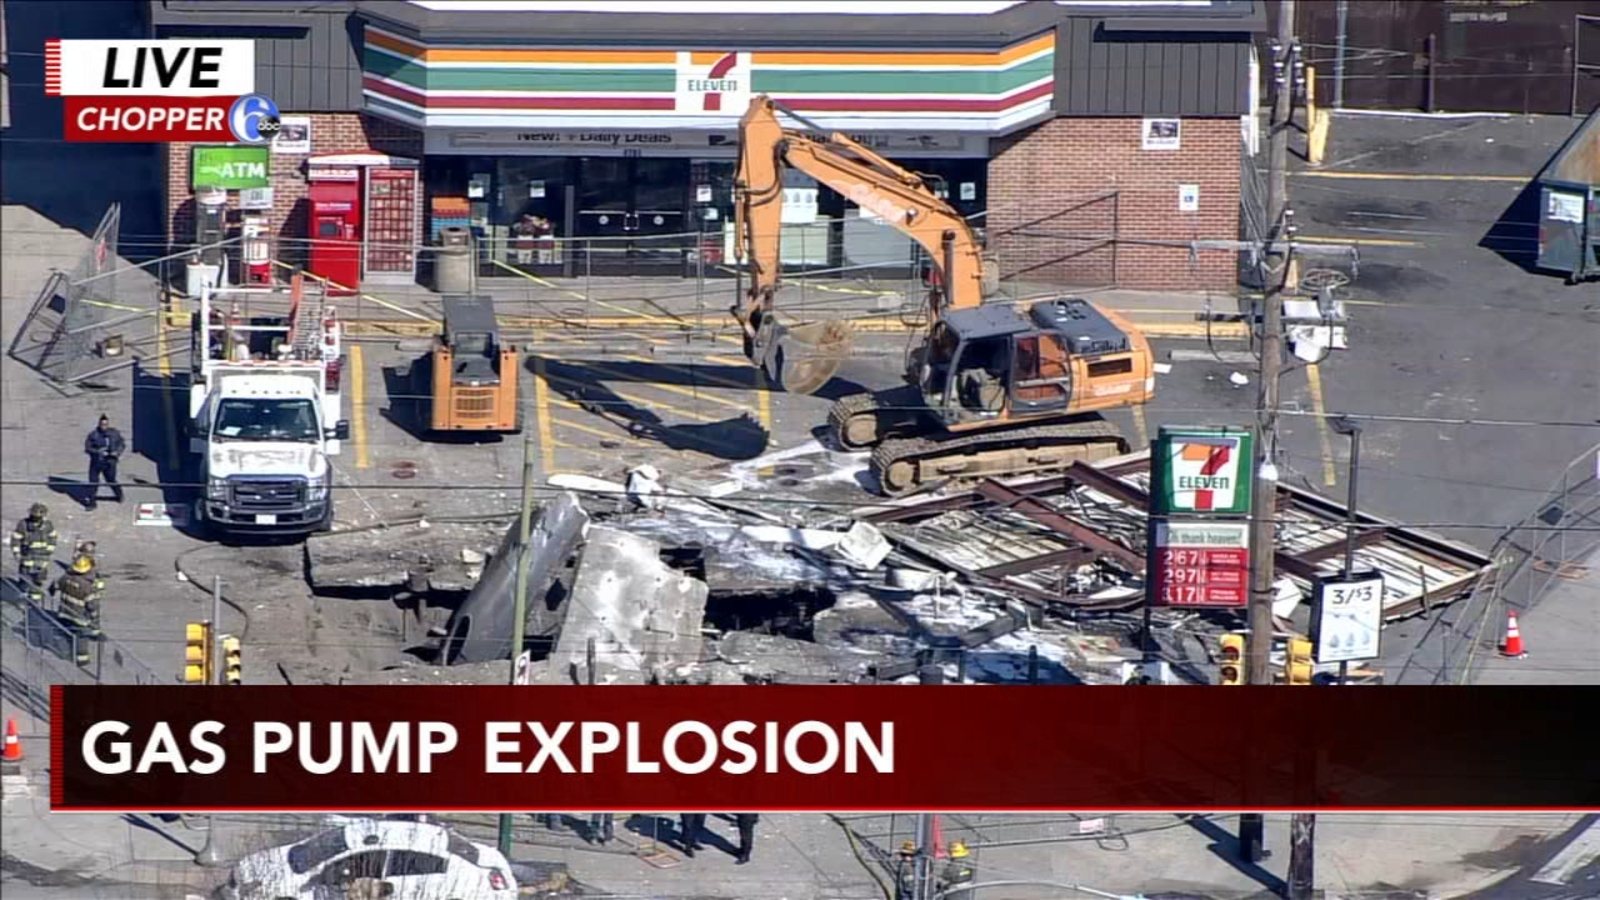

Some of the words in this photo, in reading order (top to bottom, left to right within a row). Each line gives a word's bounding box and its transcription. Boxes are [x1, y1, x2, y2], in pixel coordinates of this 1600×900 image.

[687, 80, 737, 91] ELEVEN
[220, 162, 266, 178] ATM
[1179, 476, 1229, 489] ELEVEN
